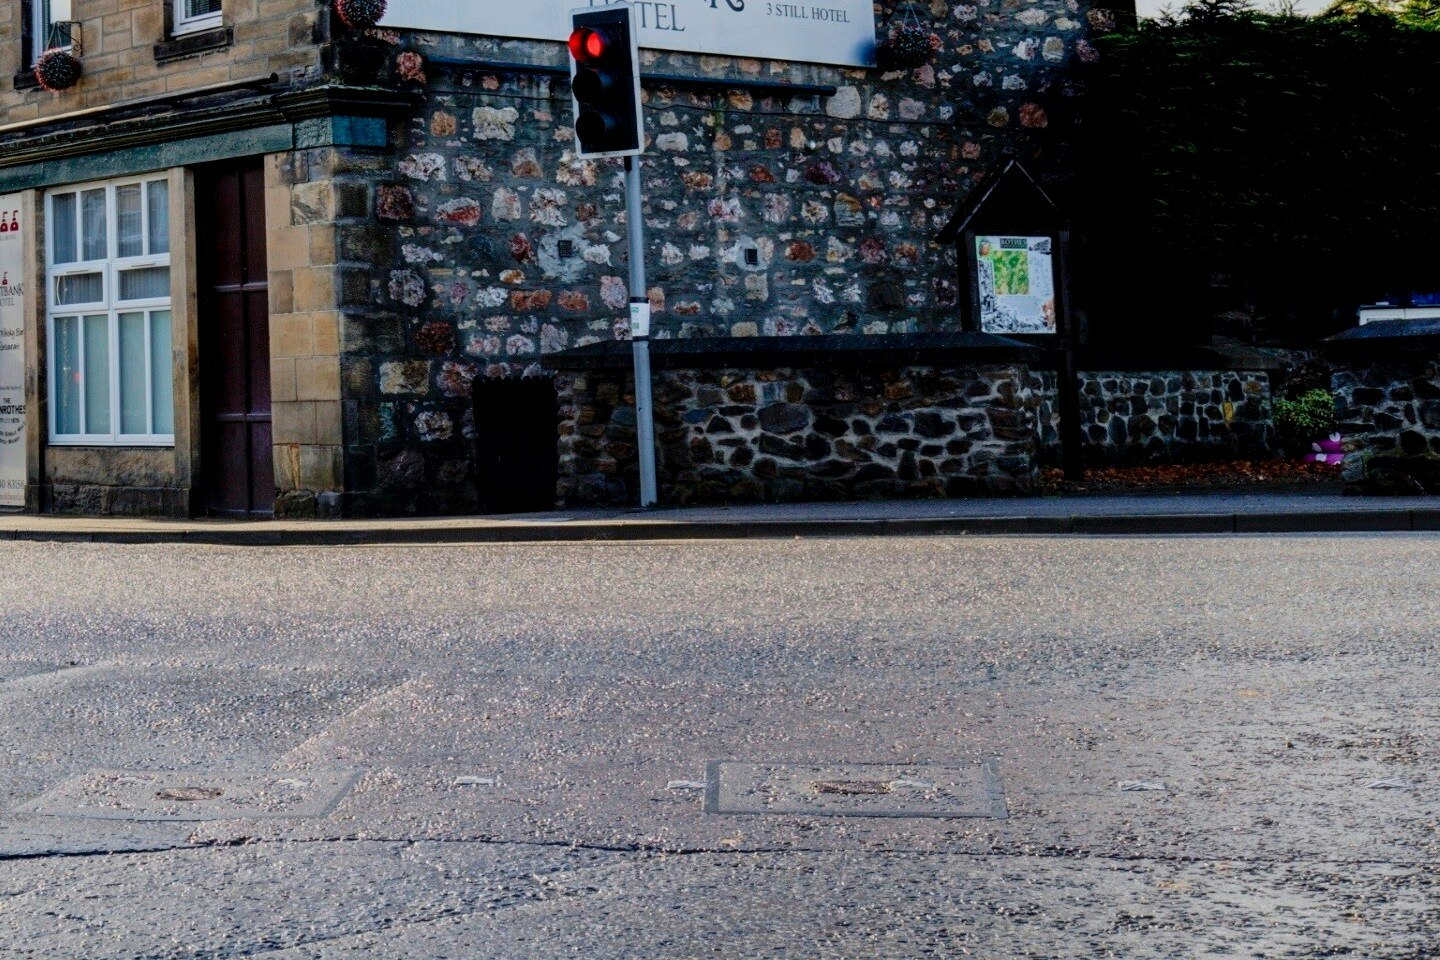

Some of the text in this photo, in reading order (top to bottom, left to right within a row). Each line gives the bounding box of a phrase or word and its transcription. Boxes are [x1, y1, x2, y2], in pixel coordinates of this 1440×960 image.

[766, 2, 850, 23] 3 STILL HOTEL
